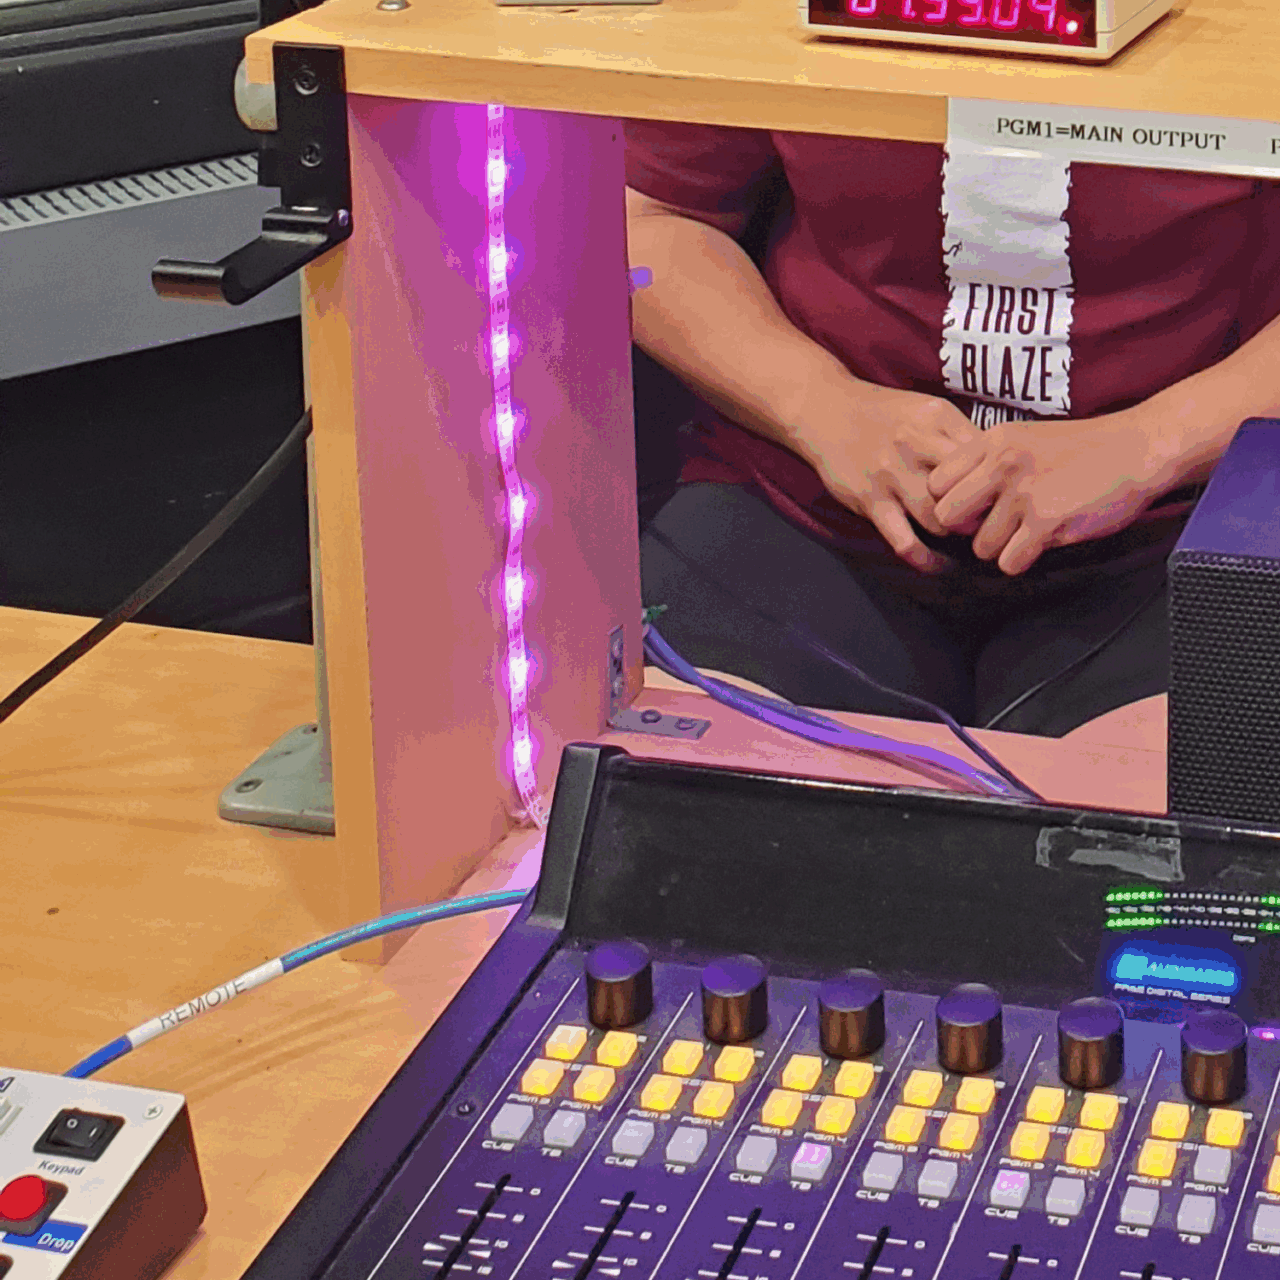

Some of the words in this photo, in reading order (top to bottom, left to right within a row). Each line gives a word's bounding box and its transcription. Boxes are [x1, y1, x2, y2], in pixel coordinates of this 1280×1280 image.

[997, 117, 1124, 143] PGM1=MAIN
[1132, 128, 1227, 151] OUTPUT
[963, 282, 1059, 336] FIRST
[961, 342, 1053, 402] BLAZE
[159, 978, 249, 1030] REMOTE
[482, 1140, 515, 1152] CUE
[38, 1160, 86, 1176] Keypad
[605, 1156, 638, 1168] CUE
[729, 1172, 763, 1185] CUE
[856, 1190, 890, 1202] CUE
[984, 1207, 1020, 1219] CUE
[1114, 1225, 1149, 1238] CUE
[38, 1232, 75, 1251] Drop
